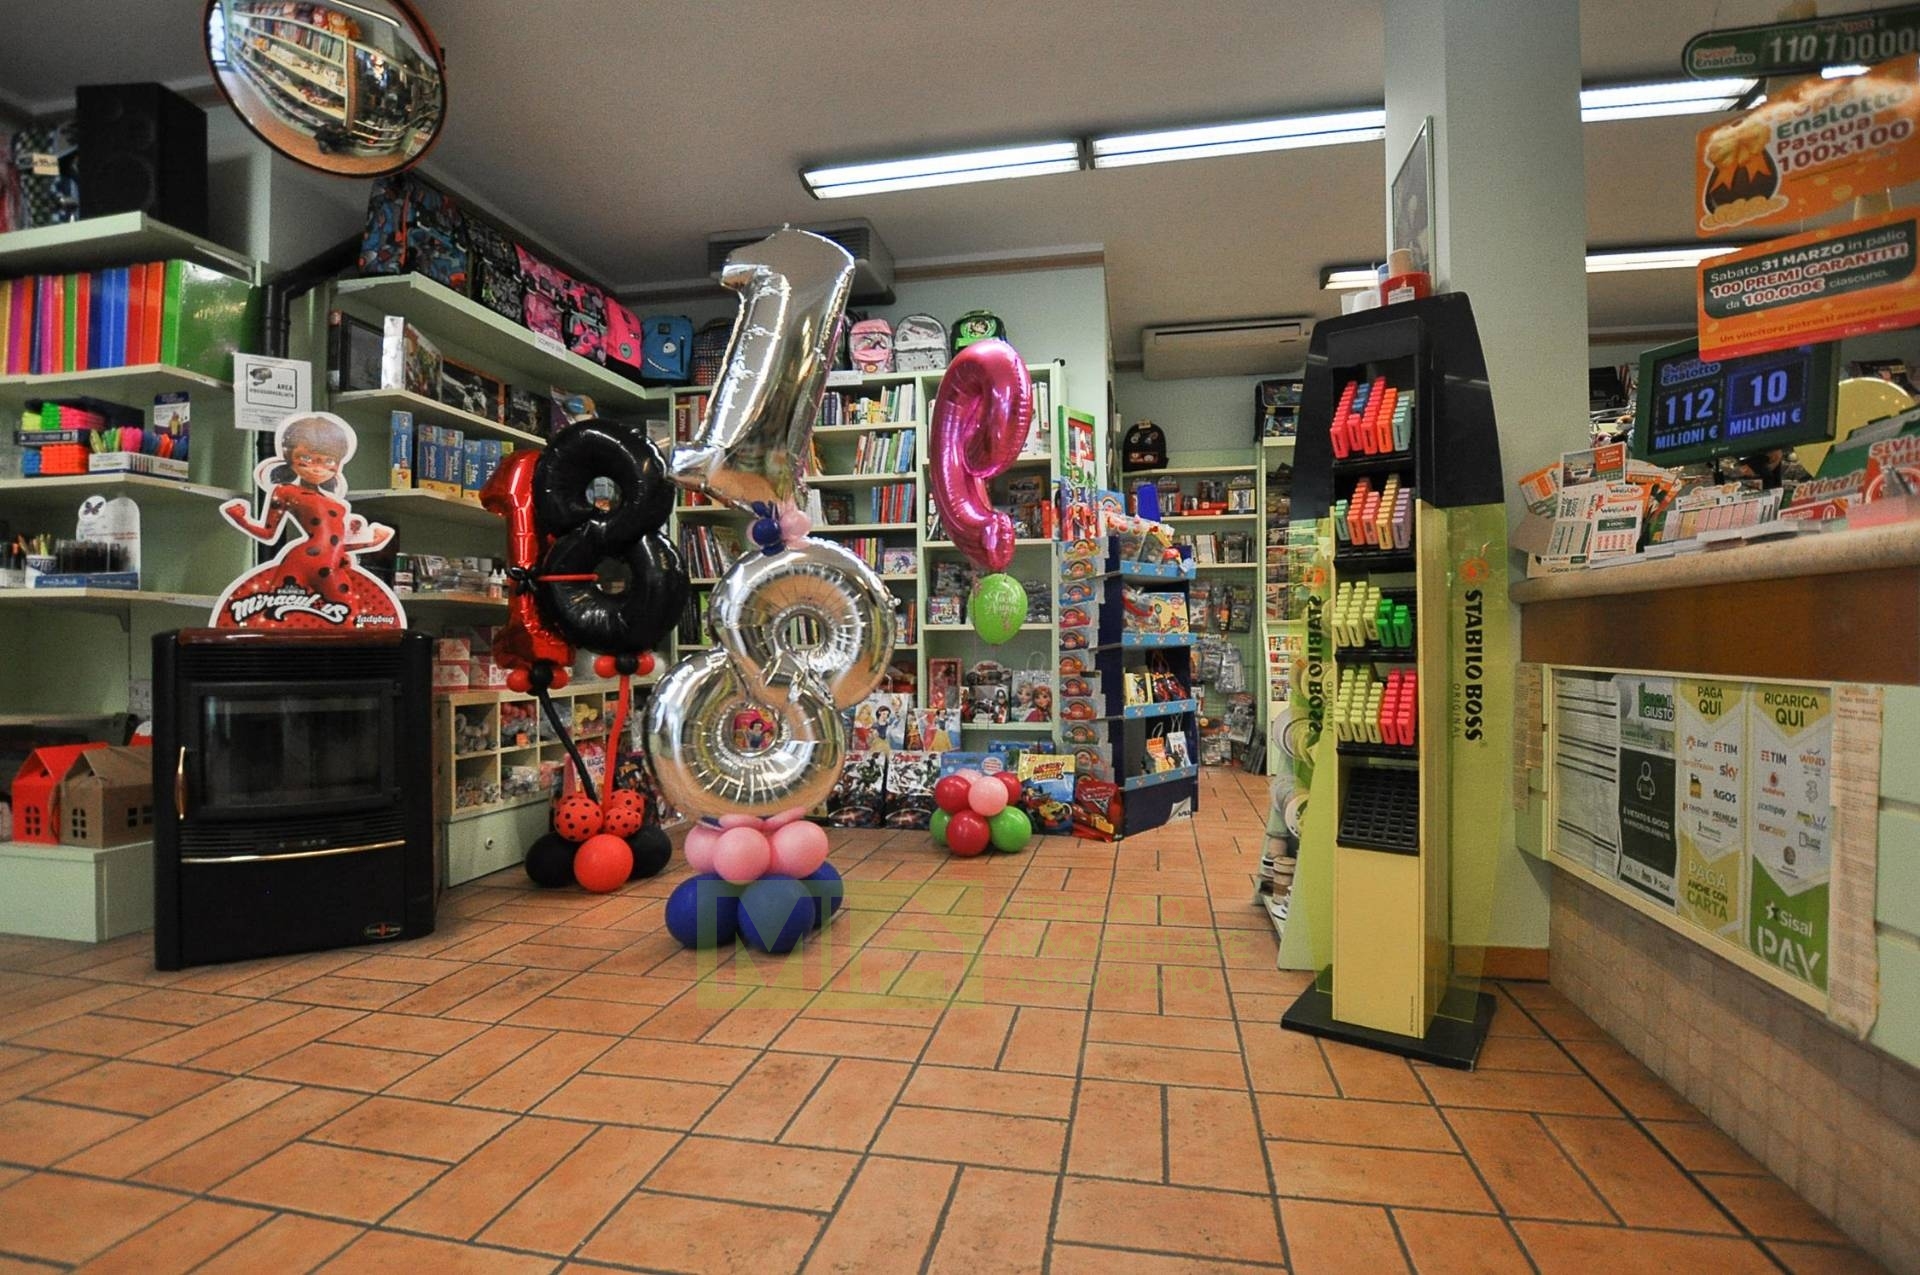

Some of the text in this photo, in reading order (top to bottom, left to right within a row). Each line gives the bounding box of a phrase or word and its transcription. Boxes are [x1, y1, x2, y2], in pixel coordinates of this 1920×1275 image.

[1777, 116, 1871, 155] Pasqua
[1778, 120, 1910, 172] 100x100
[1711, 230, 1907, 283] Sabato 31 MARZO in palio
[1711, 243, 1909, 298] 100 PREMI GARANTITI
[1726, 300, 1740, 310] da
[1743, 279, 1825, 306] 100.000€
[1720, 333, 1734, 344] Un
[1737, 325, 1785, 341] vincitore
[1751, 370, 1788, 408] 10
[1666, 387, 1716, 425] 112
[1730, 408, 1802, 436] MILIONI €
[1655, 425, 1718, 450] MILIONI €
[356, 614, 394, 625] Ladybug
[1465, 589, 1483, 741] STABILO BOSS
[1698, 686, 1723, 699] PAGA
[1764, 692, 1818, 710] RICARICA
[1453, 683, 1461, 738] ORIGINAL
[1643, 705, 1674, 721] GIUSTO
[1699, 699, 1722, 716] QUI
[1775, 708, 1804, 727] QUI
[1723, 743, 1738, 755] TIM
[1771, 752, 1787, 765] TIM
[1800, 754, 1826, 767] WIND
[1719, 762, 1738, 781] sky
[1687, 890, 1729, 921] CARTA
[1779, 911, 1813, 938] Sisal
[1757, 925, 1821, 985] PAY
